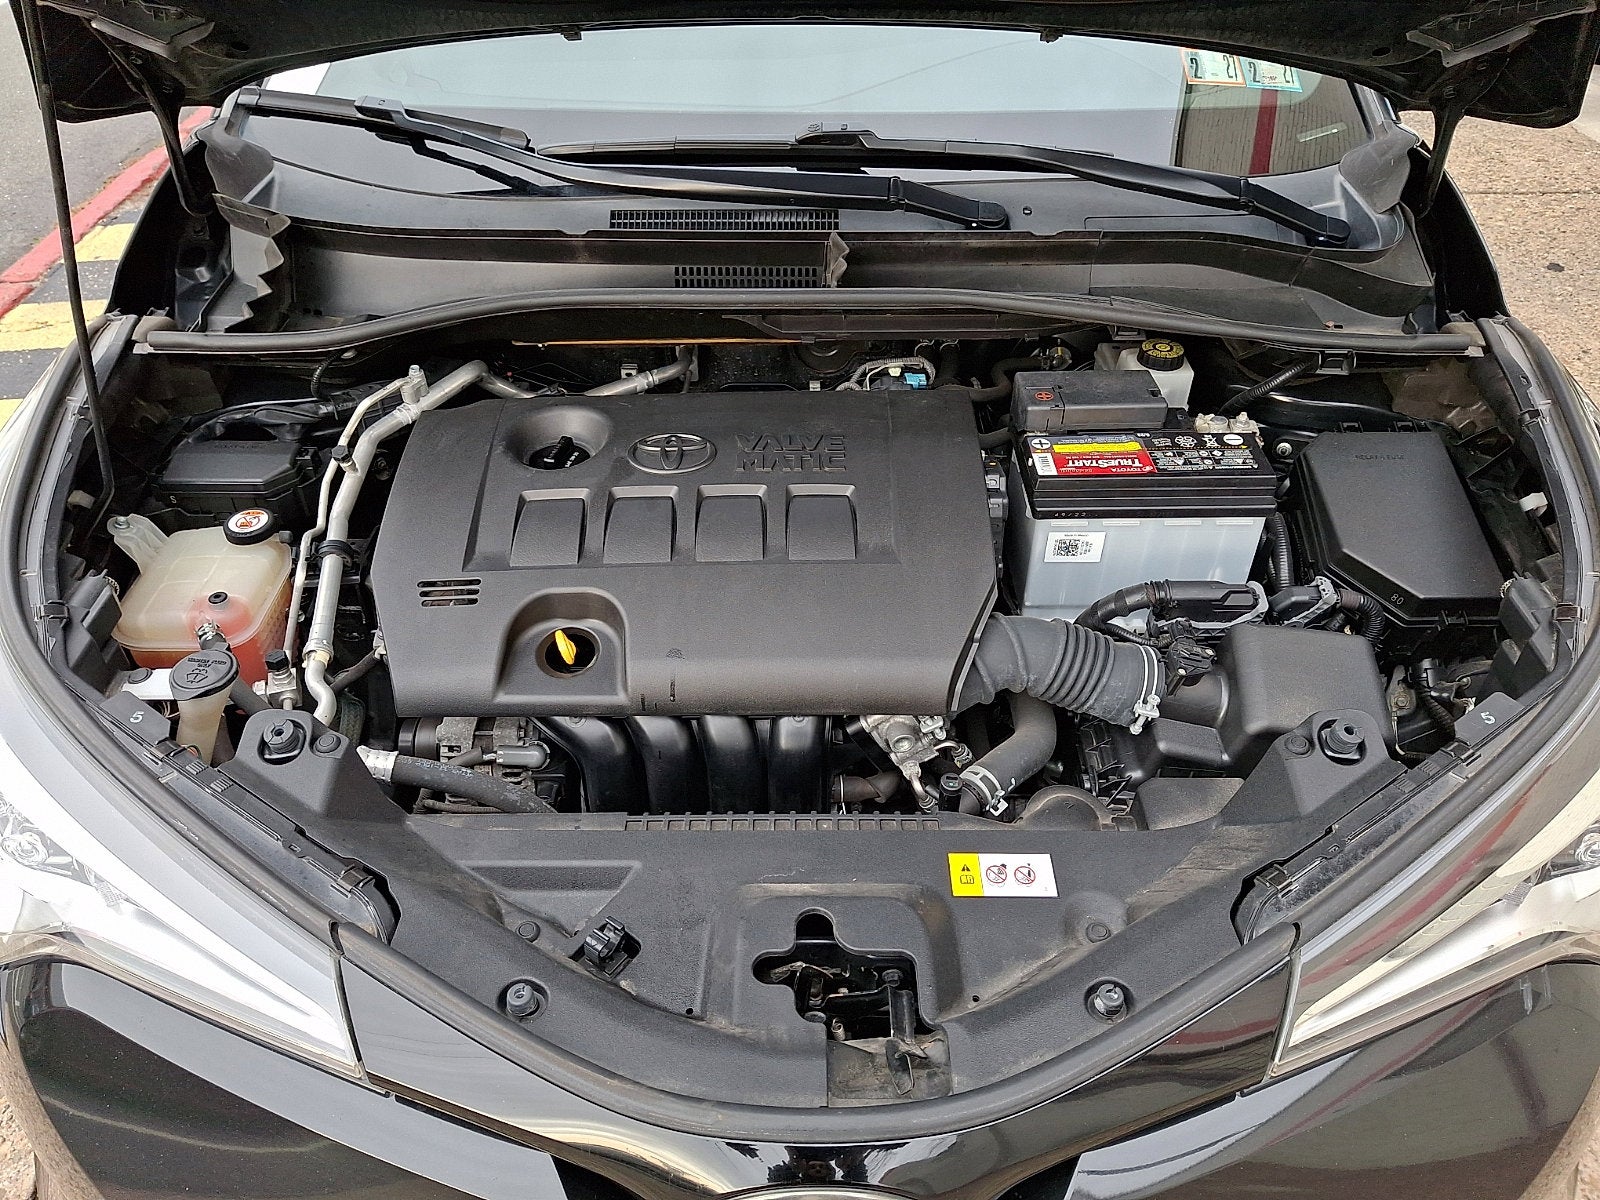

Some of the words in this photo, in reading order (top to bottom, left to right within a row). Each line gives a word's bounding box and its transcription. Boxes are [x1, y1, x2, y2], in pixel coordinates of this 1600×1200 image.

[1189, 57, 1203, 79] 2
[1247, 61, 1261, 83] 2
[736, 433, 846, 453] VALVE
[735, 453, 847, 473] MATIC
[1391, 593, 1404, 605] 80
[130, 710, 145, 723] 5
[1480, 711, 1496, 724] 5
